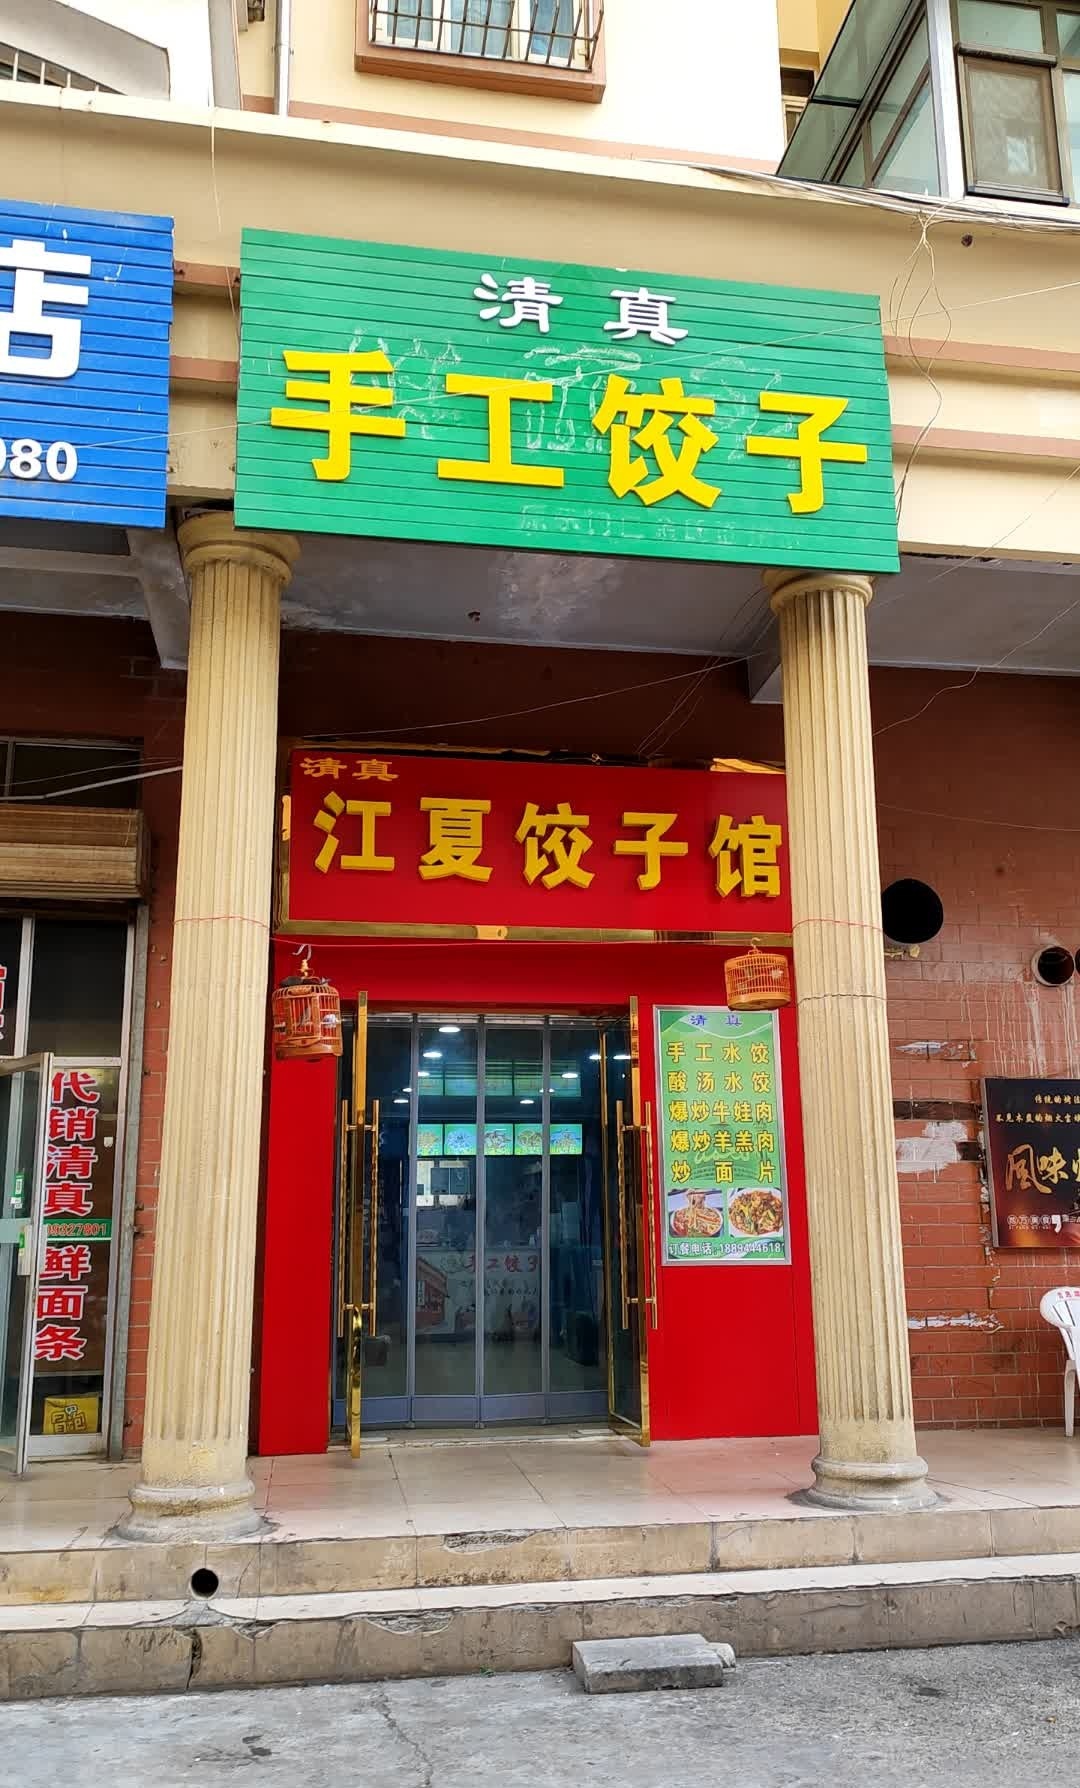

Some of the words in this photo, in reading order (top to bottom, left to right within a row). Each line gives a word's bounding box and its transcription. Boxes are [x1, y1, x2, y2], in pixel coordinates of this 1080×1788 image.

[473, 273, 689, 345] 清真
[270, 349, 868, 513] 手工饺子
[0, 436, 78, 481] 80
[299, 757, 399, 781] 清真
[313, 791, 783, 898] 江夏饺子馆
[690, 1014, 743, 1027] 清真
[666, 1041, 771, 1064] 手工水饺
[667, 1070, 773, 1093] 酸汤水饺
[670, 1129, 776, 1153] 爆炒羊羔肉
[671, 1159, 777, 1184] 炒面片
